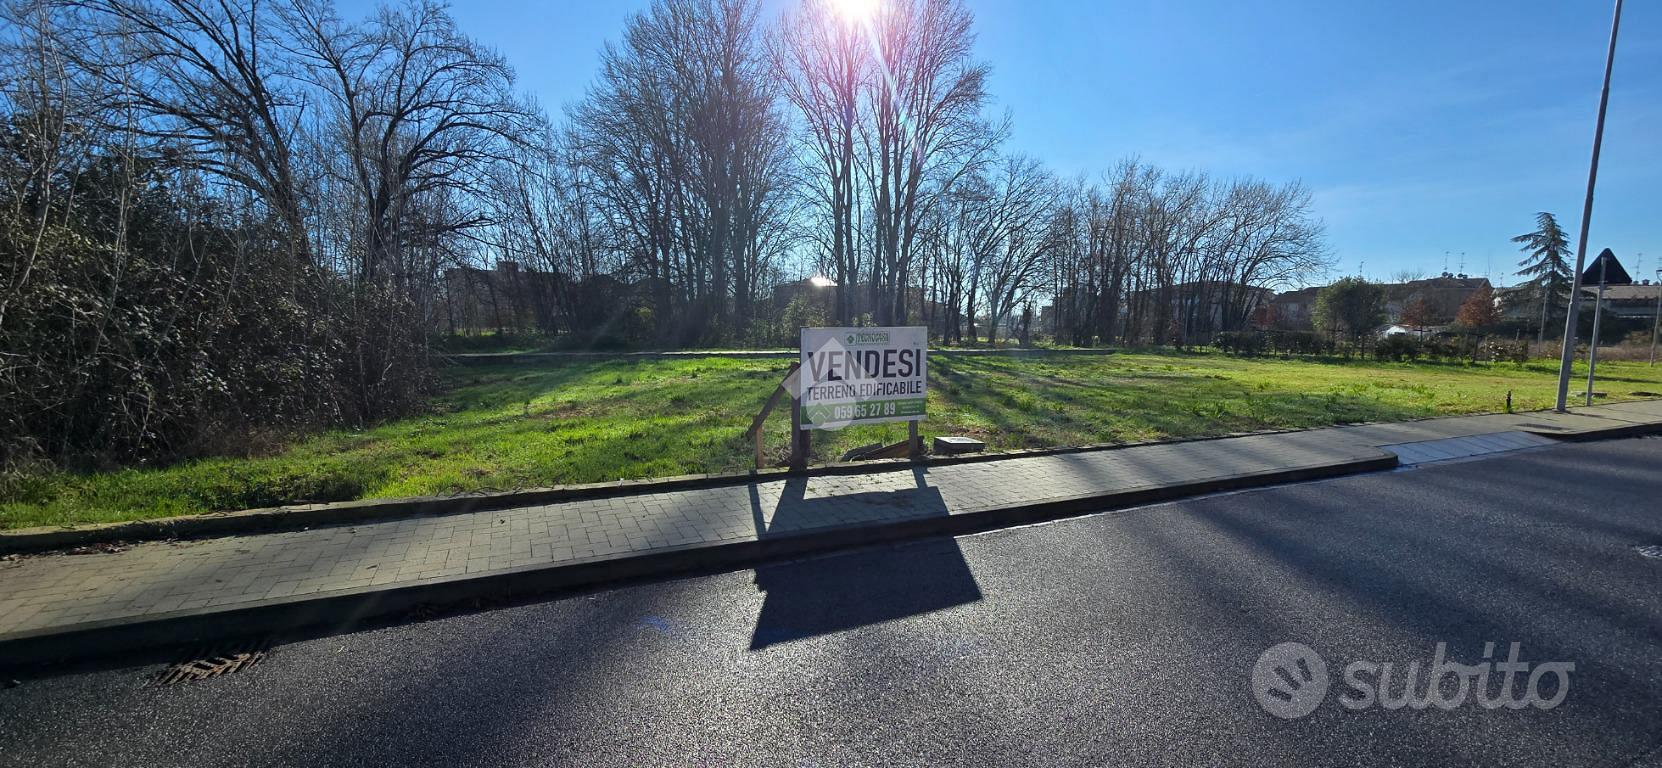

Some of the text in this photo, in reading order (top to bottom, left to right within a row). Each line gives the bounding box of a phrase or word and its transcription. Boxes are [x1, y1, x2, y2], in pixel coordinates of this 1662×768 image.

[808, 349, 920, 381] VENDESI
[808, 381, 922, 400] TERRENO EDIFICABILE
[834, 402, 896, 419] 059 65 27 89
